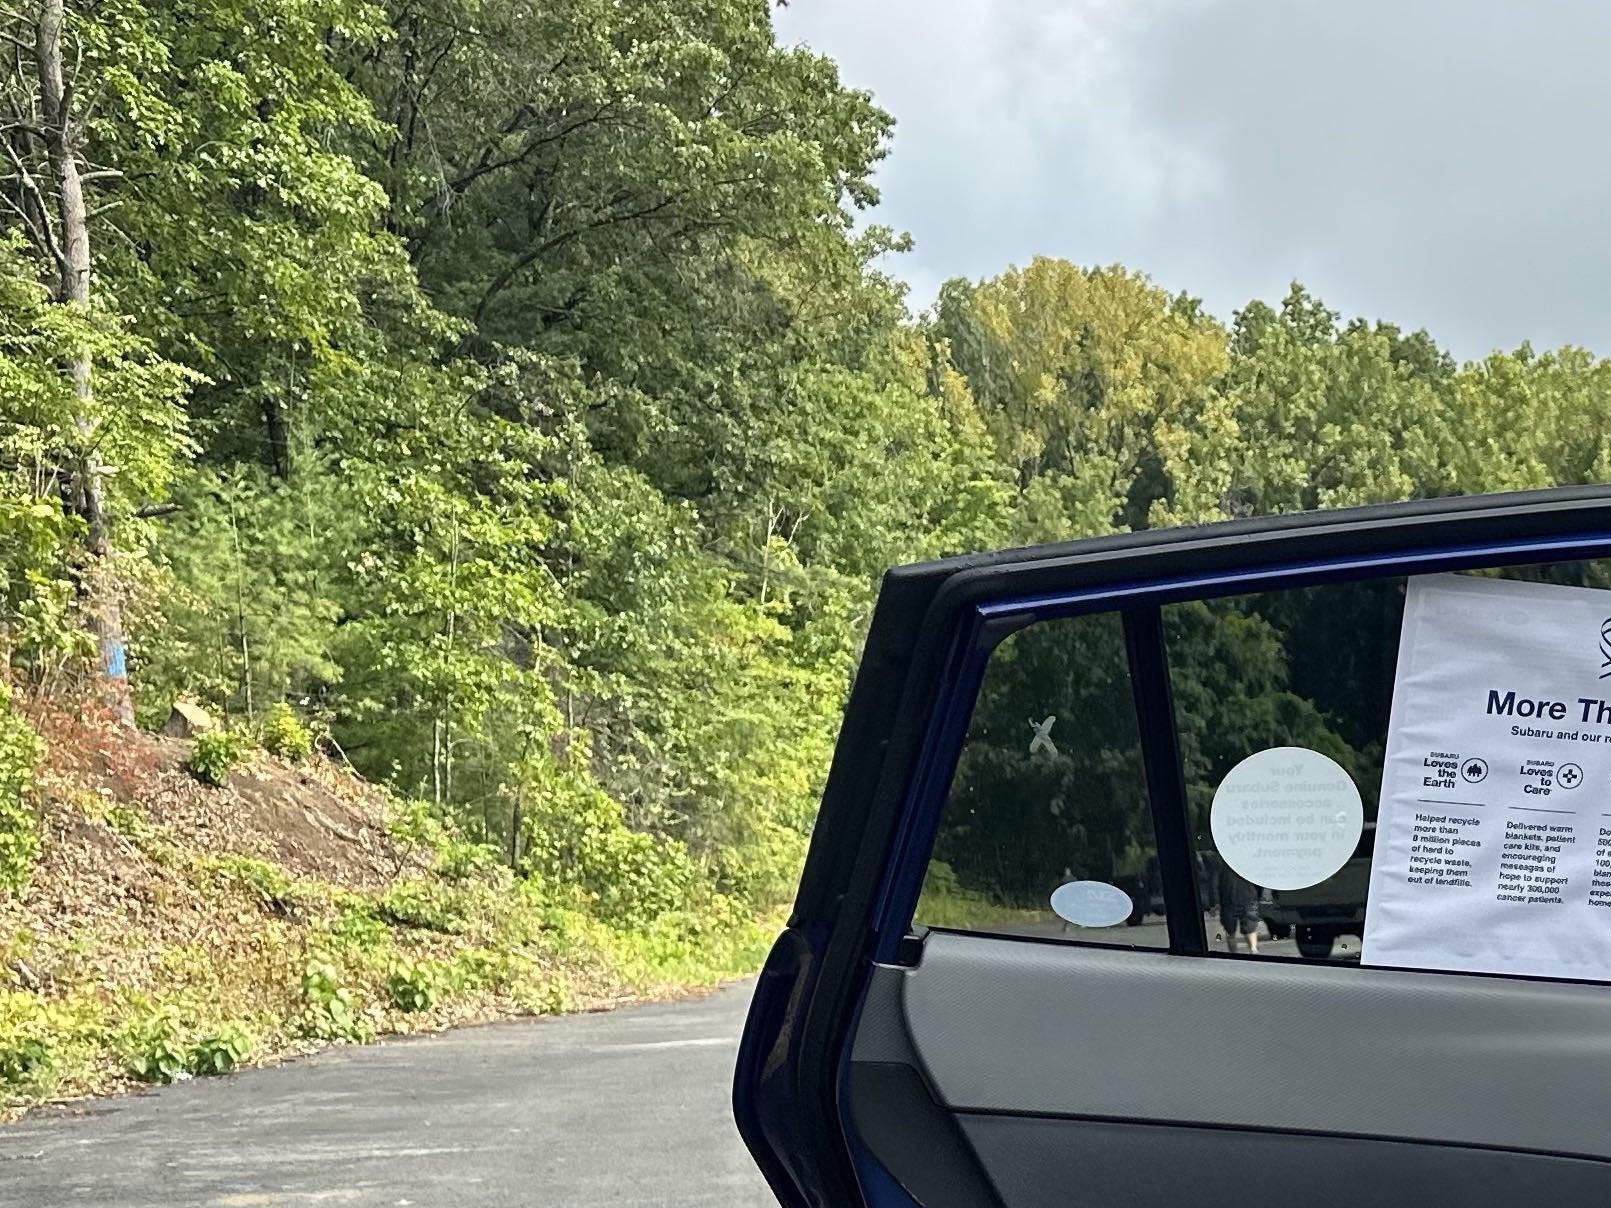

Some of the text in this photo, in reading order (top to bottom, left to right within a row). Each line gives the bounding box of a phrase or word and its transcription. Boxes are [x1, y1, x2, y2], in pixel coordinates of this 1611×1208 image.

[1486, 690, 1567, 720] More
[1511, 726, 1553, 739] Subaru
[1557, 731, 1579, 741] and
[1582, 734, 1601, 743] our
[1424, 758, 1458, 769] Loves
[1438, 769, 1456, 778] the
[1520, 766, 1553, 777] Loves
[1423, 777, 1455, 788] Earth
[1541, 778, 1551, 786] to
[1524, 785, 1551, 795] Care
[1415, 814, 1480, 826] Helped recycle
[1507, 822, 1547, 832] Delivered
[1420, 836, 1450, 844] million
[1423, 846, 1442, 854] hard
[1410, 856, 1442, 865] recycle
[1502, 853, 1556, 864] encouraging
[1409, 866, 1468, 876] keeping them
[1500, 863, 1544, 873] messages
[1499, 872, 1521, 881] hope
[1535, 876, 1568, 885] support
[1498, 883, 1524, 893] nearly
